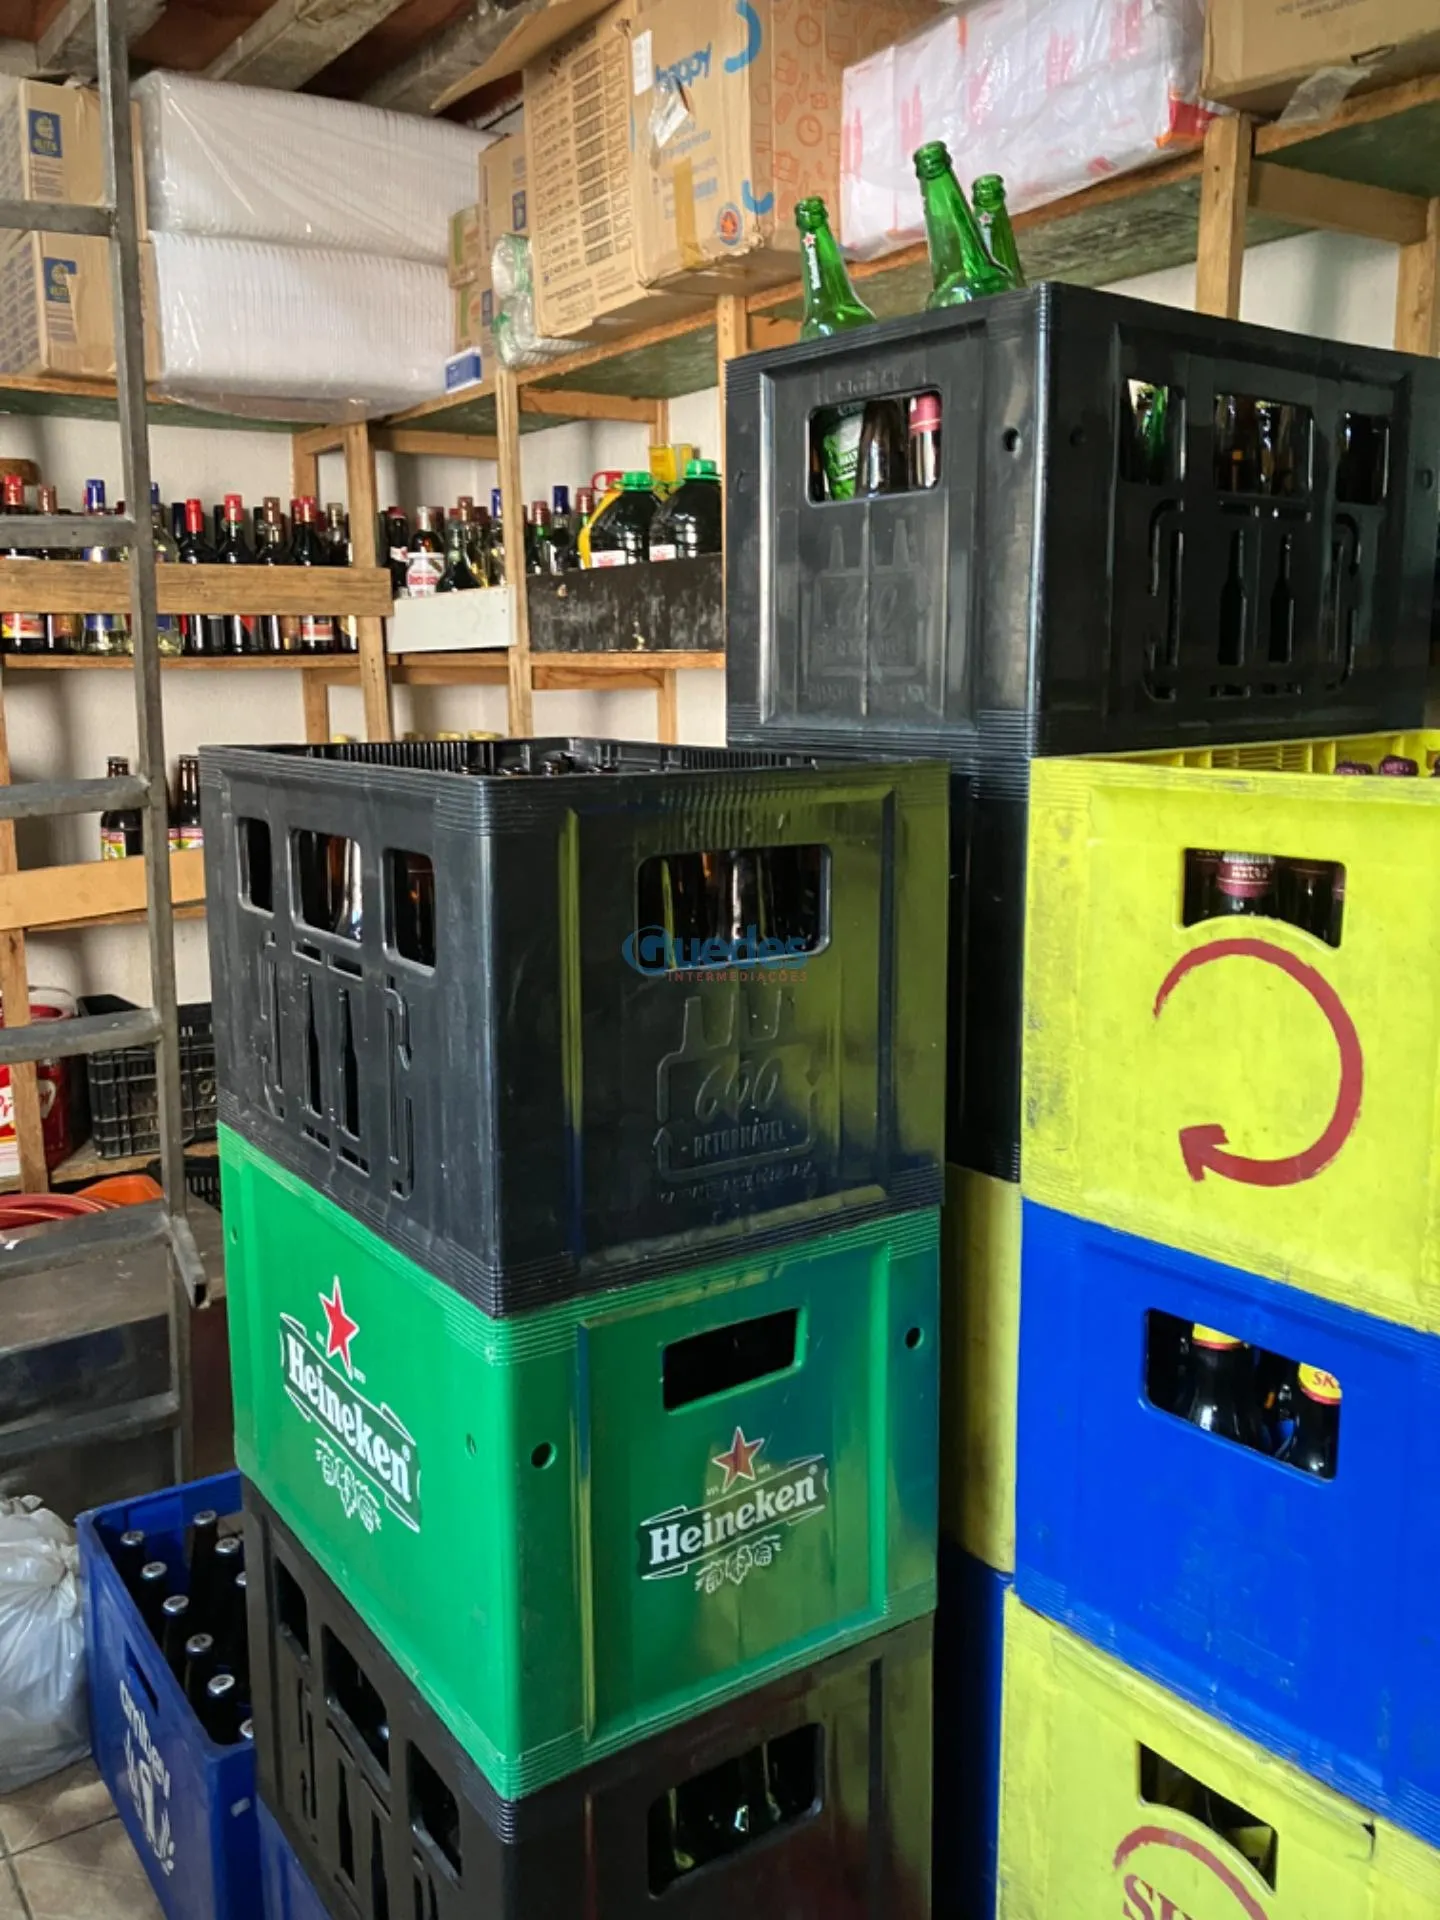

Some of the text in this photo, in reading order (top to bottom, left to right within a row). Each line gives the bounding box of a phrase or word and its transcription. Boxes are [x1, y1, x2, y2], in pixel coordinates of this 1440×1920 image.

[694, 1057, 783, 1121] 600
[286, 1333, 412, 1503] Heineken
[648, 1466, 818, 1566] Heineken
